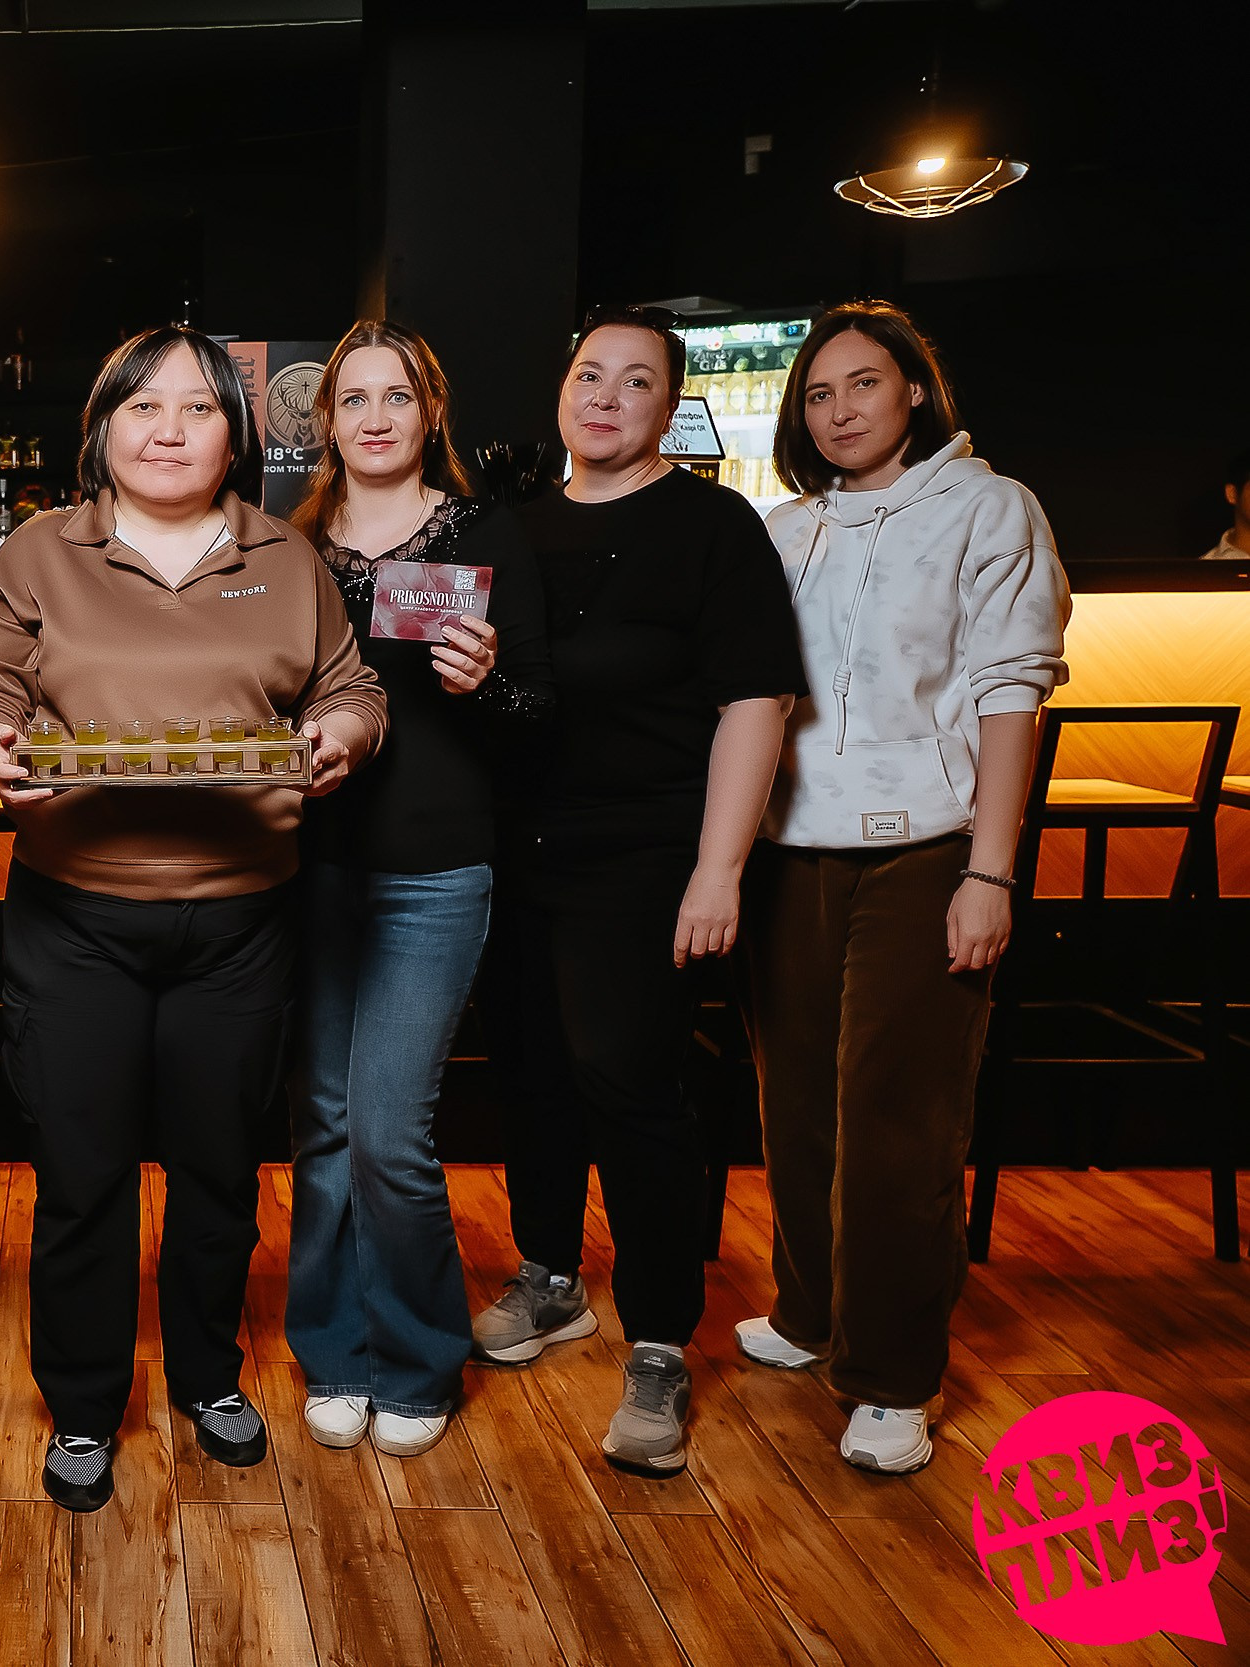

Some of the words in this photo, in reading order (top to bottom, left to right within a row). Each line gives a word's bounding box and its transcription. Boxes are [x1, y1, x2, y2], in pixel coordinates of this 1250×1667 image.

[263, 465, 285, 473] ROM
[286, 465, 305, 473] THE
[221, 590, 240, 598] NEW
[241, 585, 267, 596] YORK
[390, 589, 477, 609] PRIKOSNOVENIE
